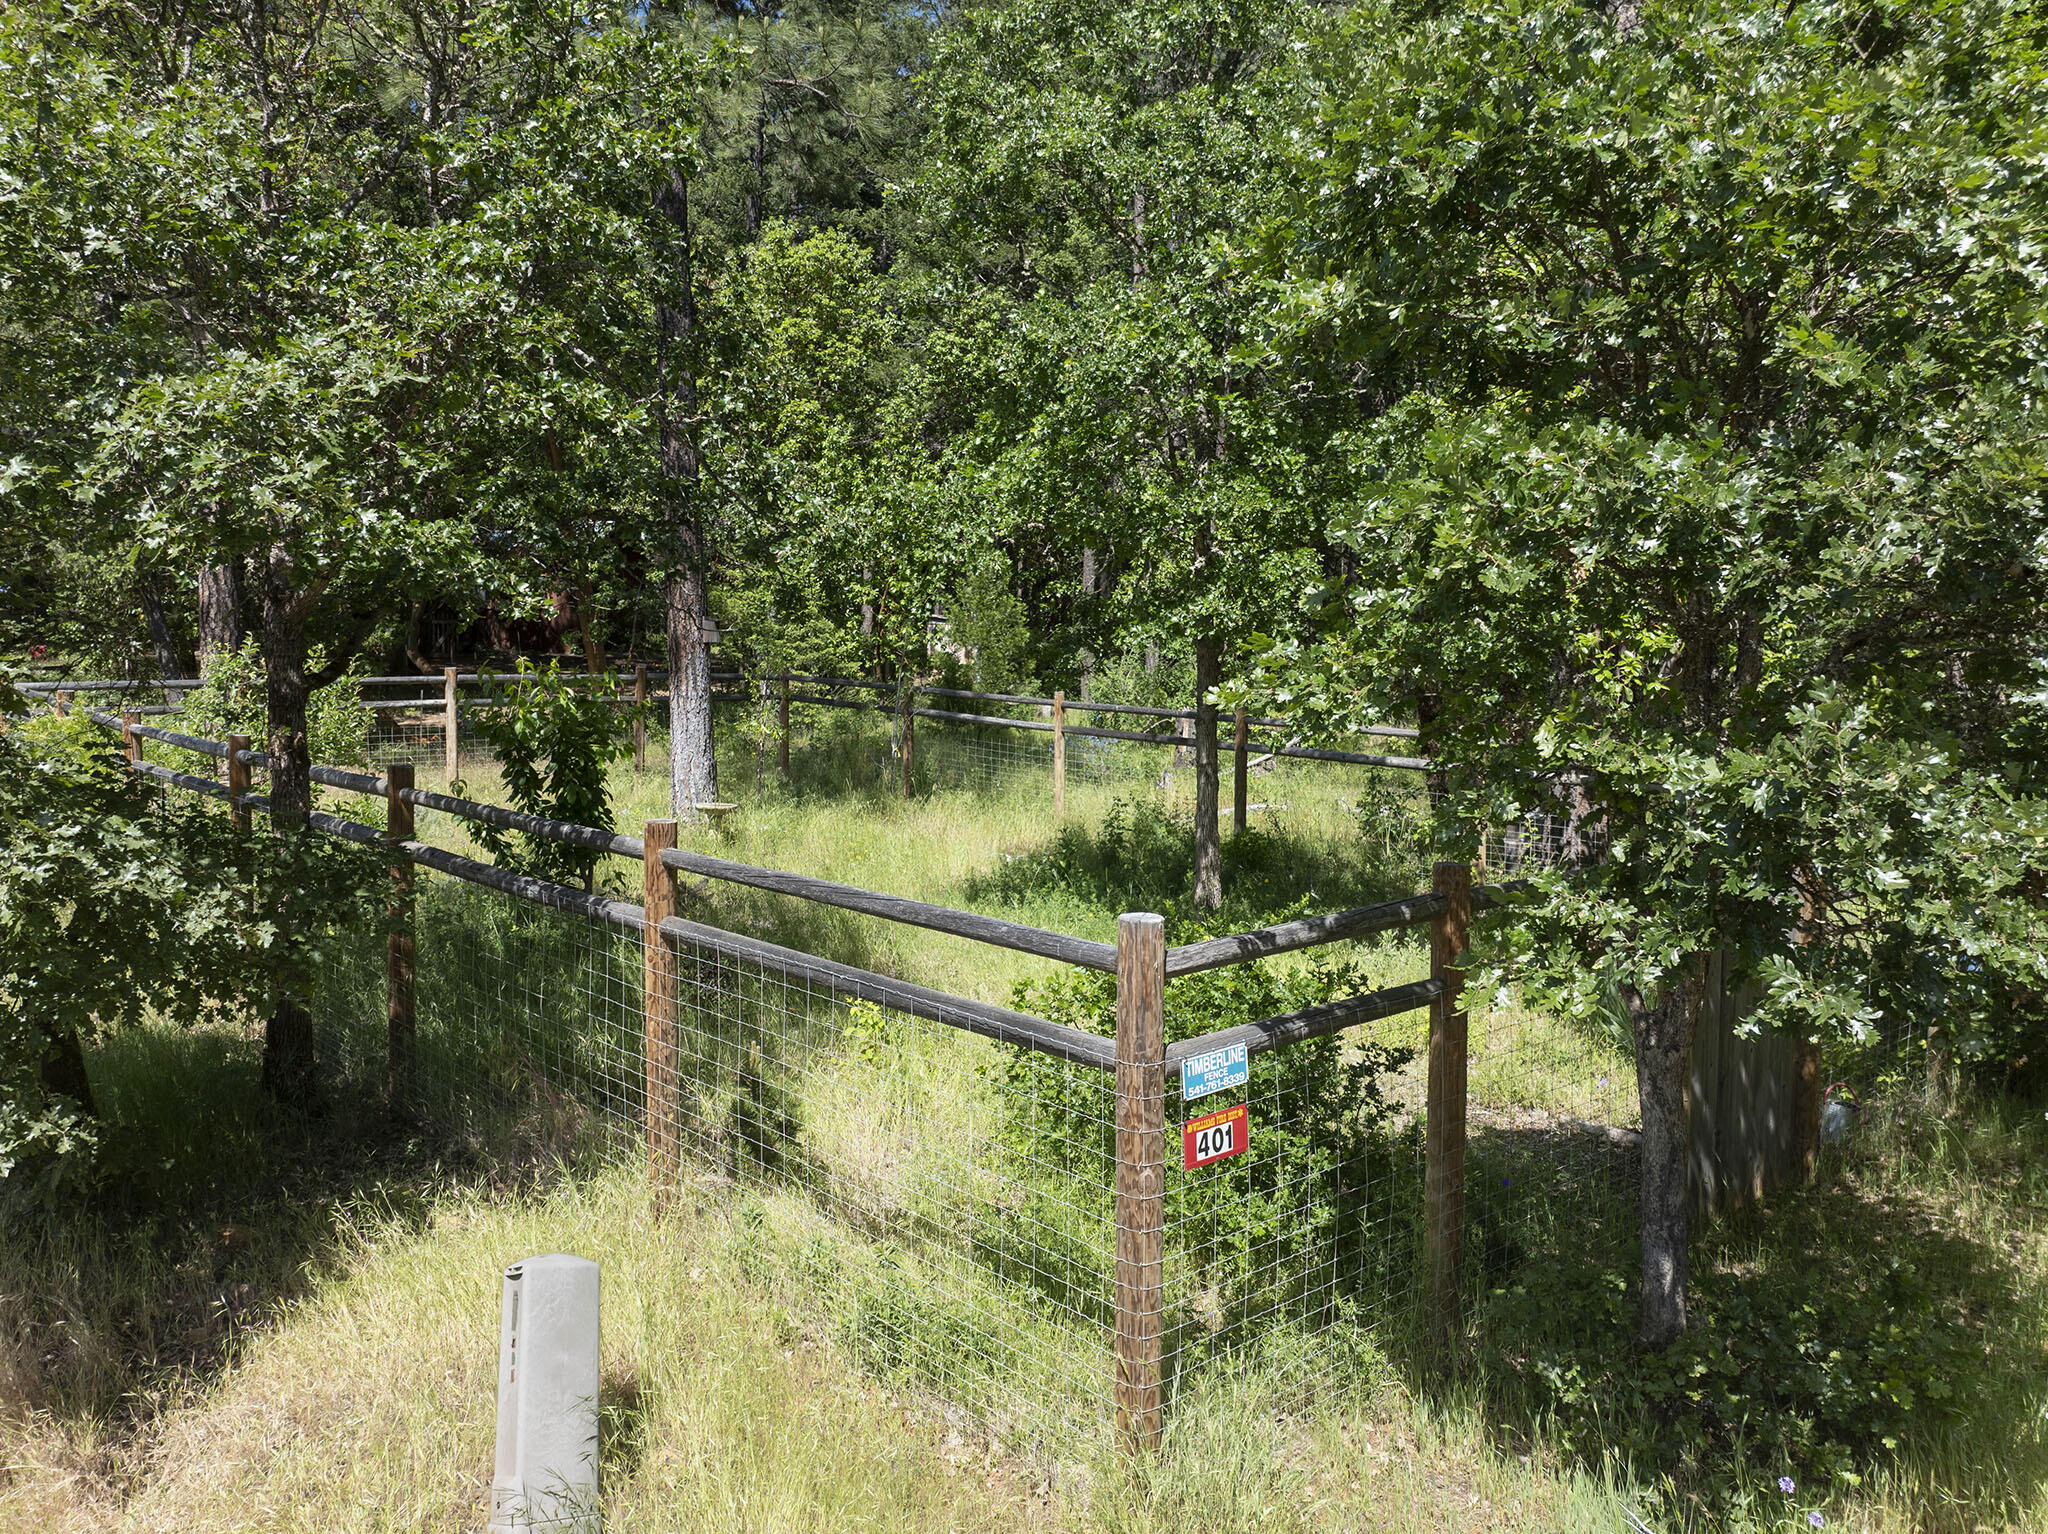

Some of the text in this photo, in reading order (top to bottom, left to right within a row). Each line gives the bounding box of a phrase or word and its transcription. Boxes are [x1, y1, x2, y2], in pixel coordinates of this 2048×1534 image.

[1187, 1047, 1245, 1077] TIMBERLINE
[1204, 1067, 1229, 1082] FENCE
[1188, 1072, 1245, 1097] 541-761-8339
[1198, 1124, 1232, 1157] 401
